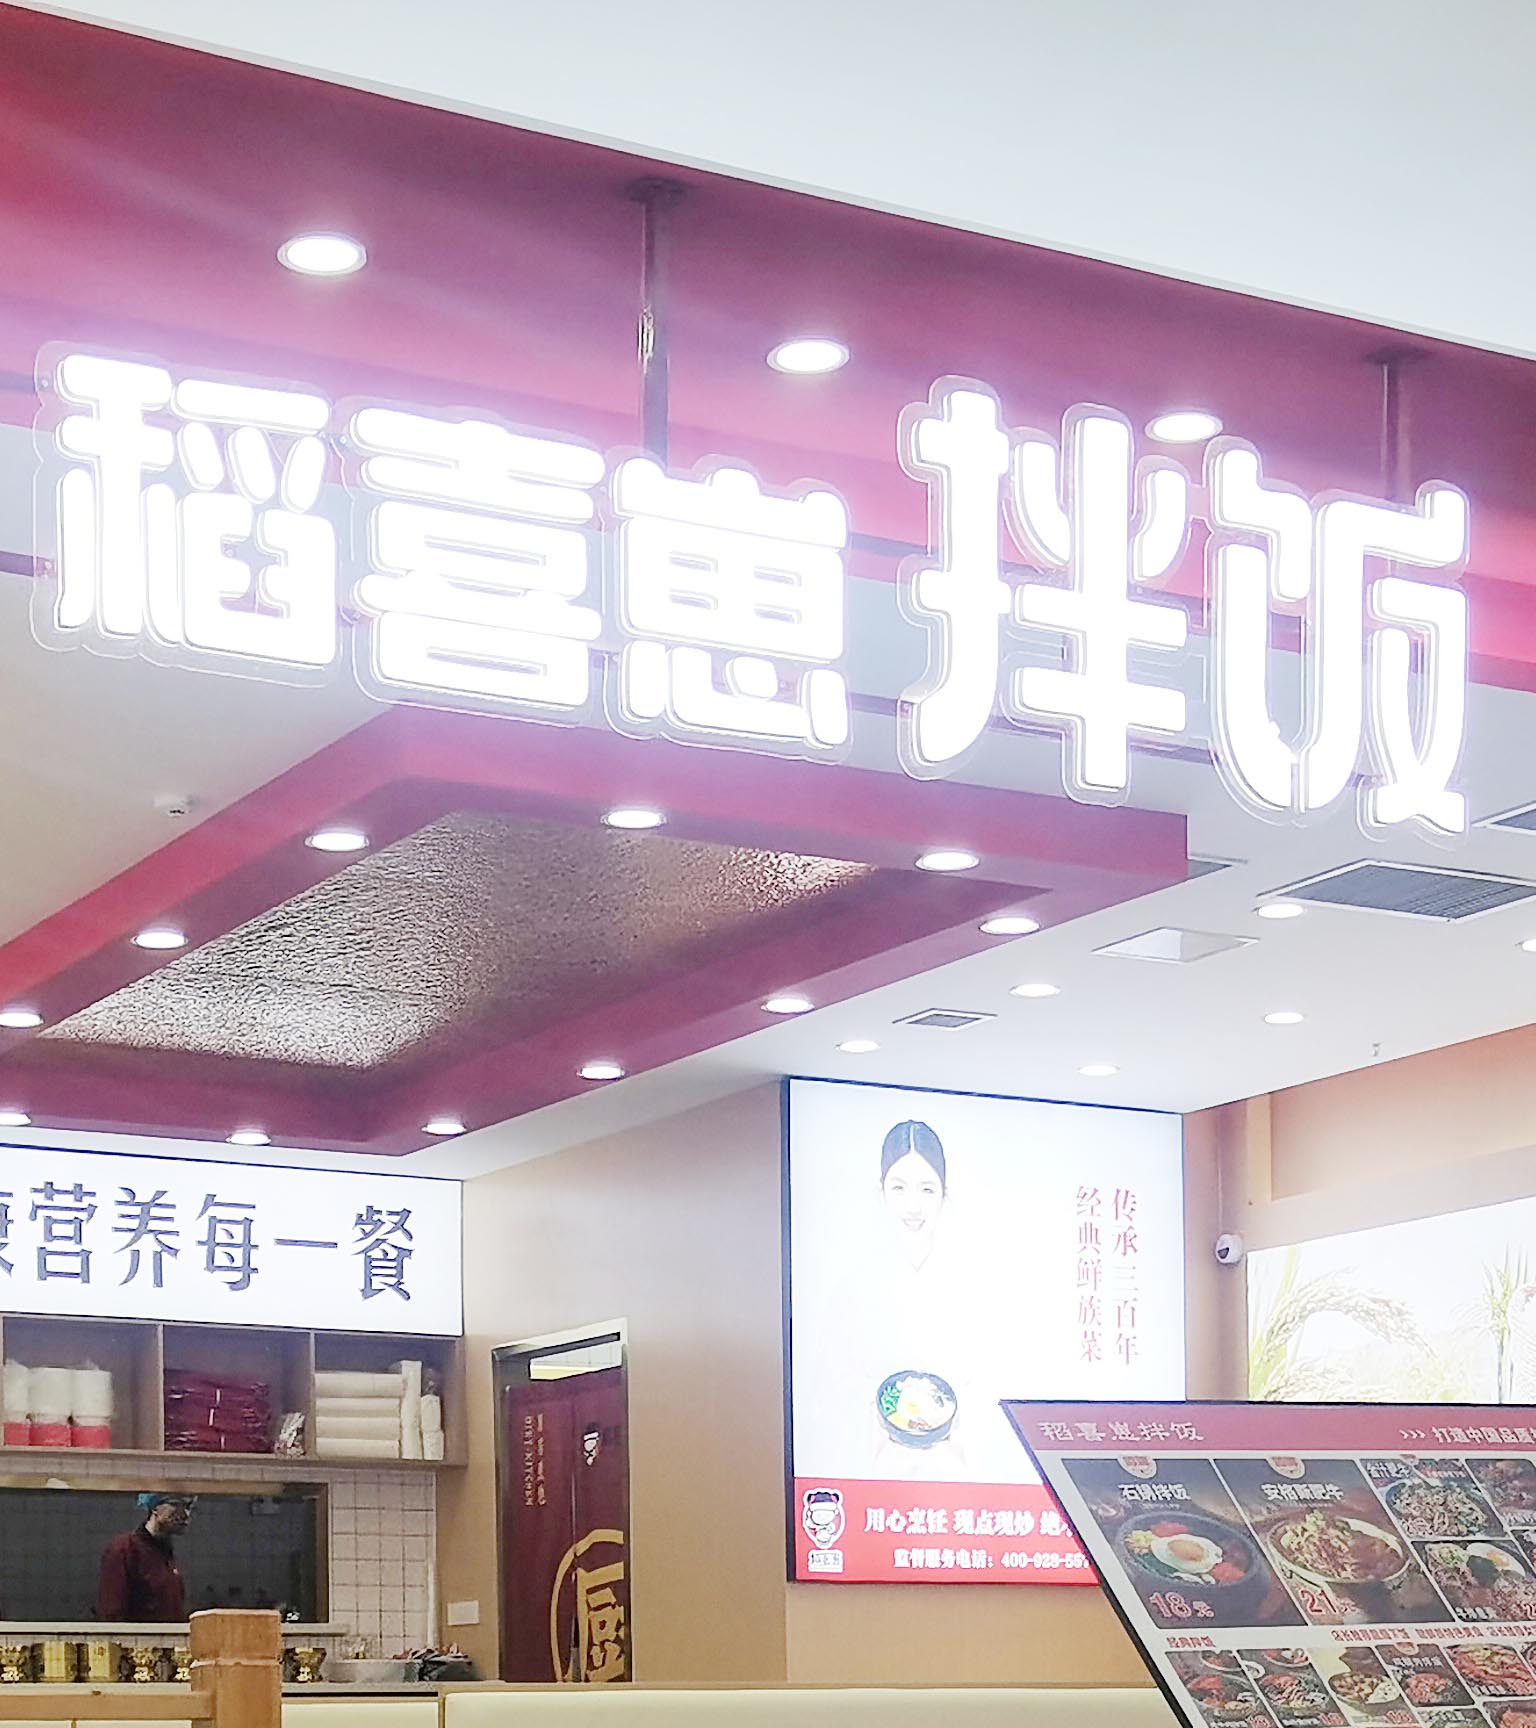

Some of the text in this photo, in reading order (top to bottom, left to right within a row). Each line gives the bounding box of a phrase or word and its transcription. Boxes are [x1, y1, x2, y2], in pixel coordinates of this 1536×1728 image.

[52, 350, 1468, 836] 稻喜崽拌饭
[1075, 1184, 1104, 1364] 经典鲜族菜
[1111, 1187, 1140, 1366] 传承三百年
